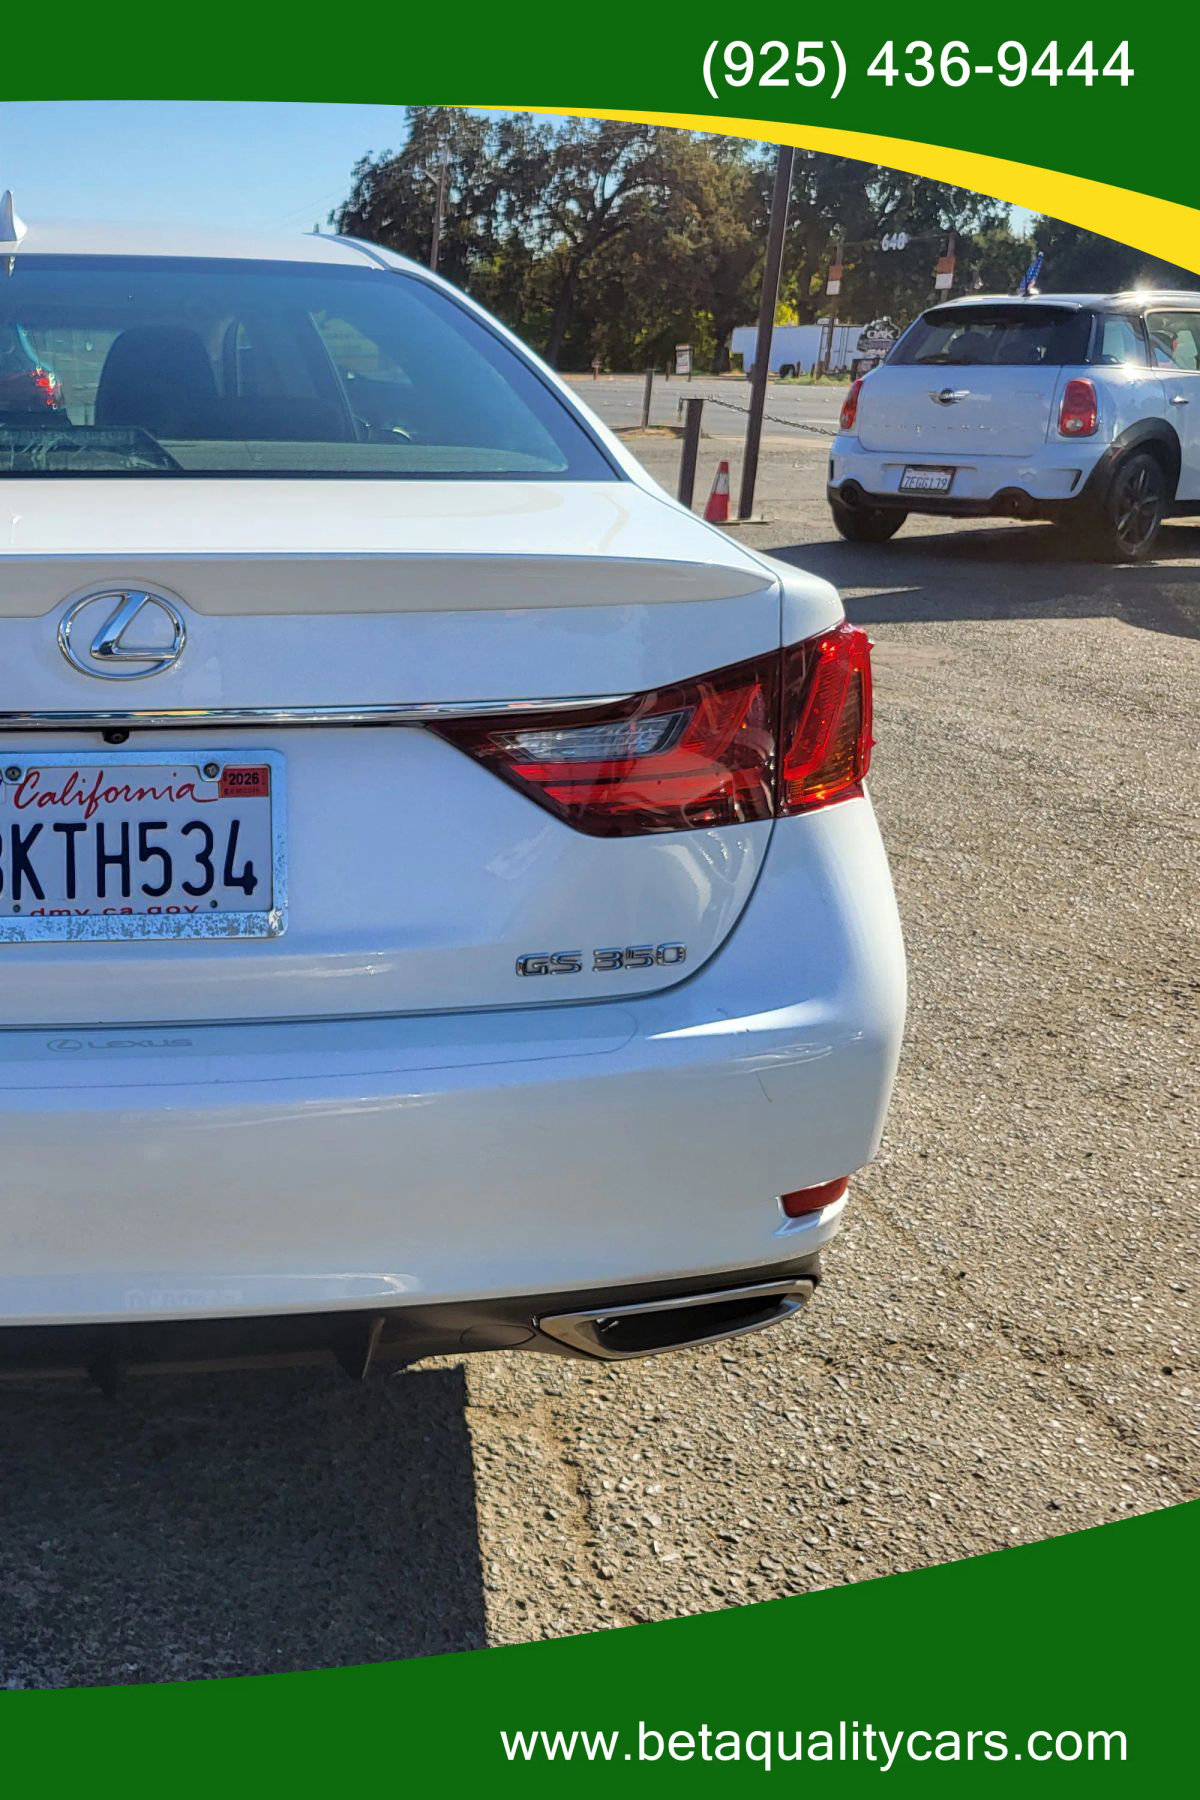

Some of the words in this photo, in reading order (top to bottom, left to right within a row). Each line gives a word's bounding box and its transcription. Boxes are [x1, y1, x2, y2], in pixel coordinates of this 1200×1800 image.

[228, 773, 260, 785] 2026
[13, 770, 219, 820] California
[30, 905, 199, 917] dmvca.gov
[515, 950, 583, 977] GS
[592, 942, 687, 973] 350
[88, 1038, 193, 1049] LEXUS
